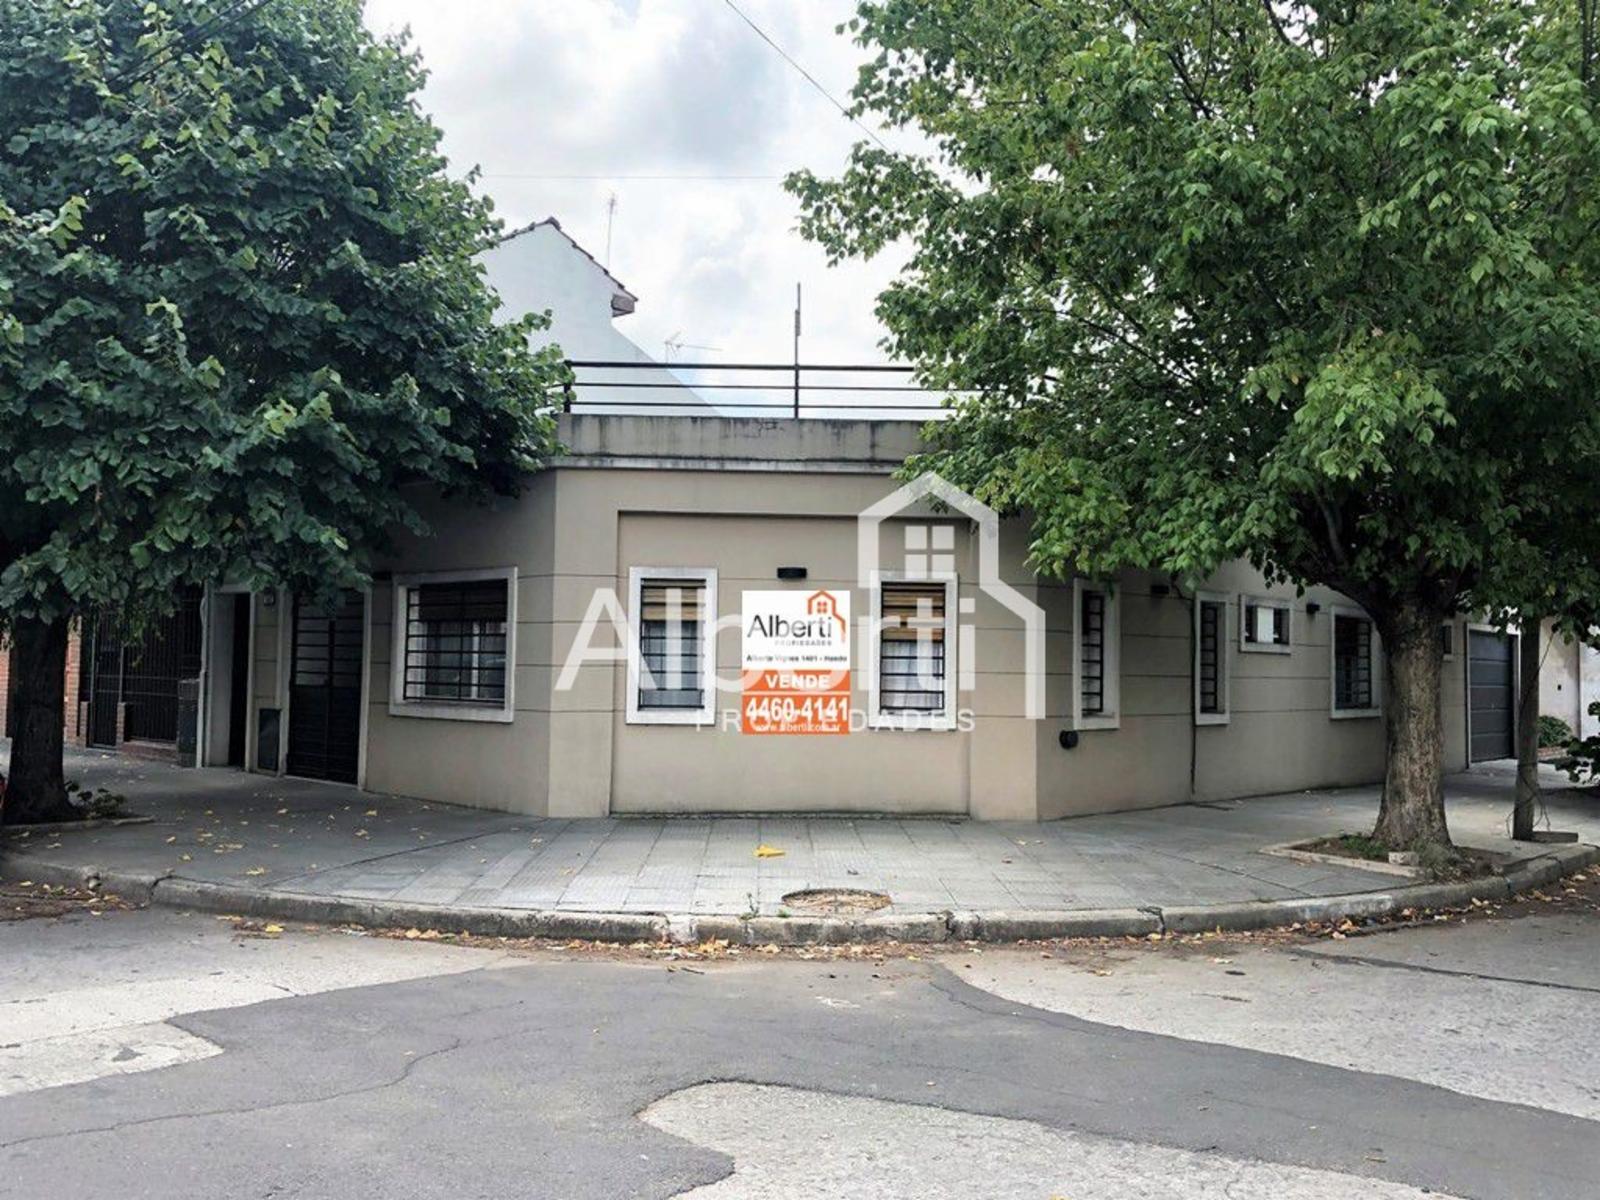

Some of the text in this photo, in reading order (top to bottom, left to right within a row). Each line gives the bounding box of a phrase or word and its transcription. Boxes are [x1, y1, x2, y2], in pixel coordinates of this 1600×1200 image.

[747, 614, 832, 638] Alberti
[765, 674, 831, 689] VENDE
[746, 697, 848, 721] 4460-4141
